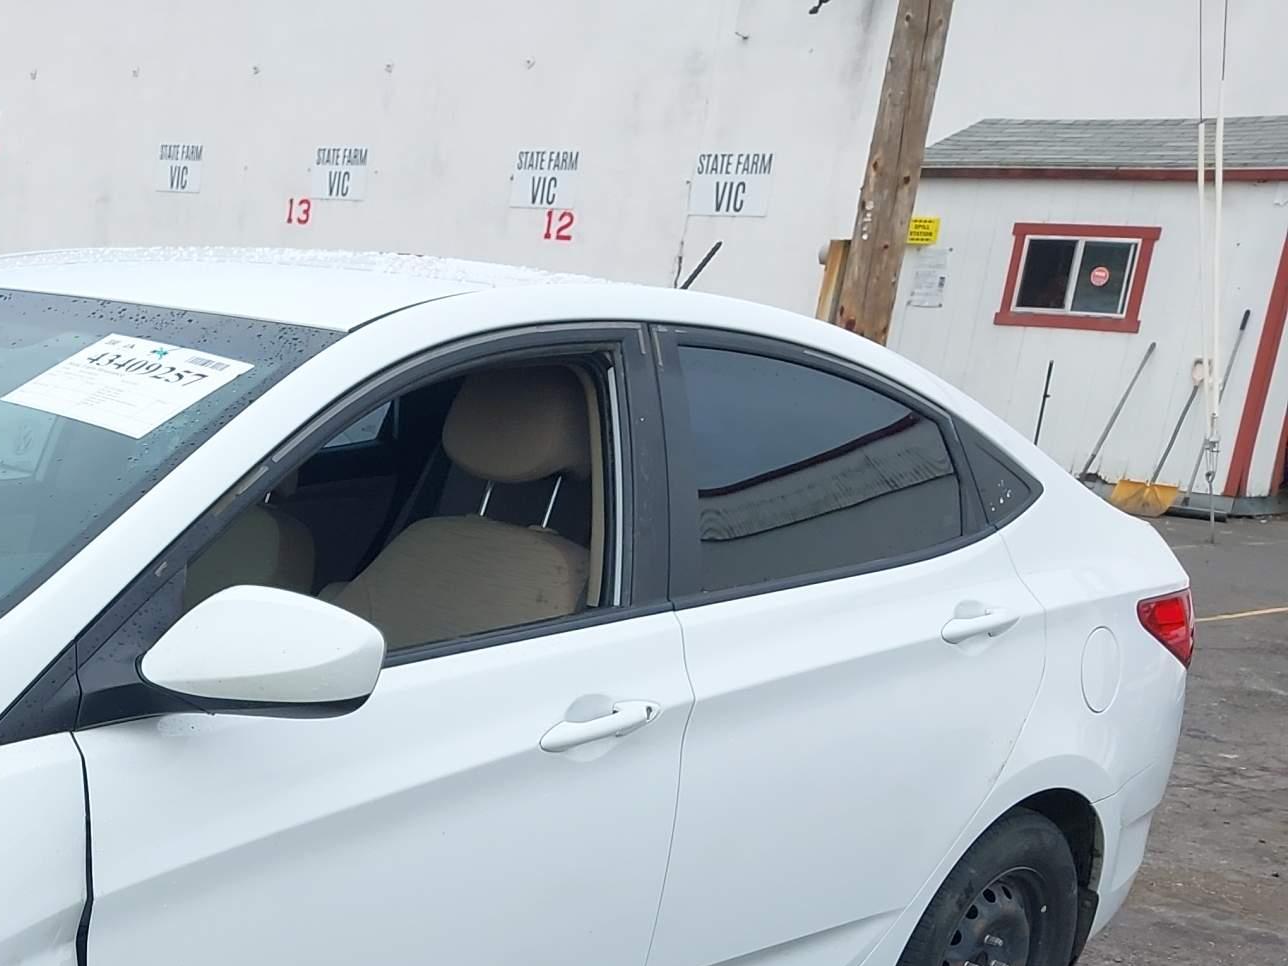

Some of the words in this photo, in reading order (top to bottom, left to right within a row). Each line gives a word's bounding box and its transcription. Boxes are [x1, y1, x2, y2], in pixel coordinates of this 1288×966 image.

[316, 148, 341, 166] STATE
[342, 148, 368, 166] FARM
[516, 151, 546, 170] STATE
[547, 151, 579, 171] FARM
[697, 153, 734, 175] STATE
[735, 153, 774, 175] FARM
[170, 165, 189, 190] VIC
[328, 171, 351, 197] VIC
[531, 176, 557, 206] VIC
[715, 181, 746, 213] VIC
[286, 198, 311, 225] 13
[543, 209, 574, 241] 12
[87, 352, 209, 387] 43409257
